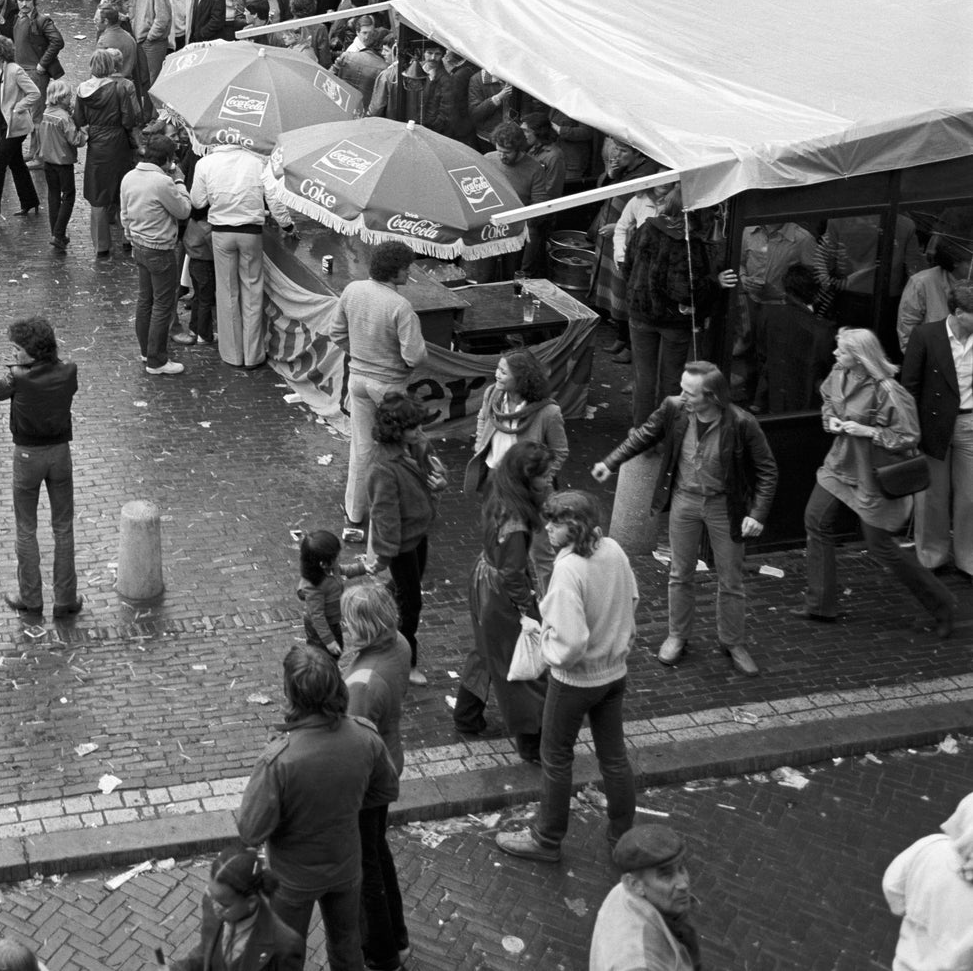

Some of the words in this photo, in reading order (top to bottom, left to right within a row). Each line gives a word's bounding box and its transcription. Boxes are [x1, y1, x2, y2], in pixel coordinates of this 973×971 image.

[225, 95, 266, 110] Coca-Cola
[216, 129, 255, 148] Coke
[299, 179, 337, 208] Coke
[387, 214, 443, 239] Coca-Cola
[481, 224, 509, 241] Coke
